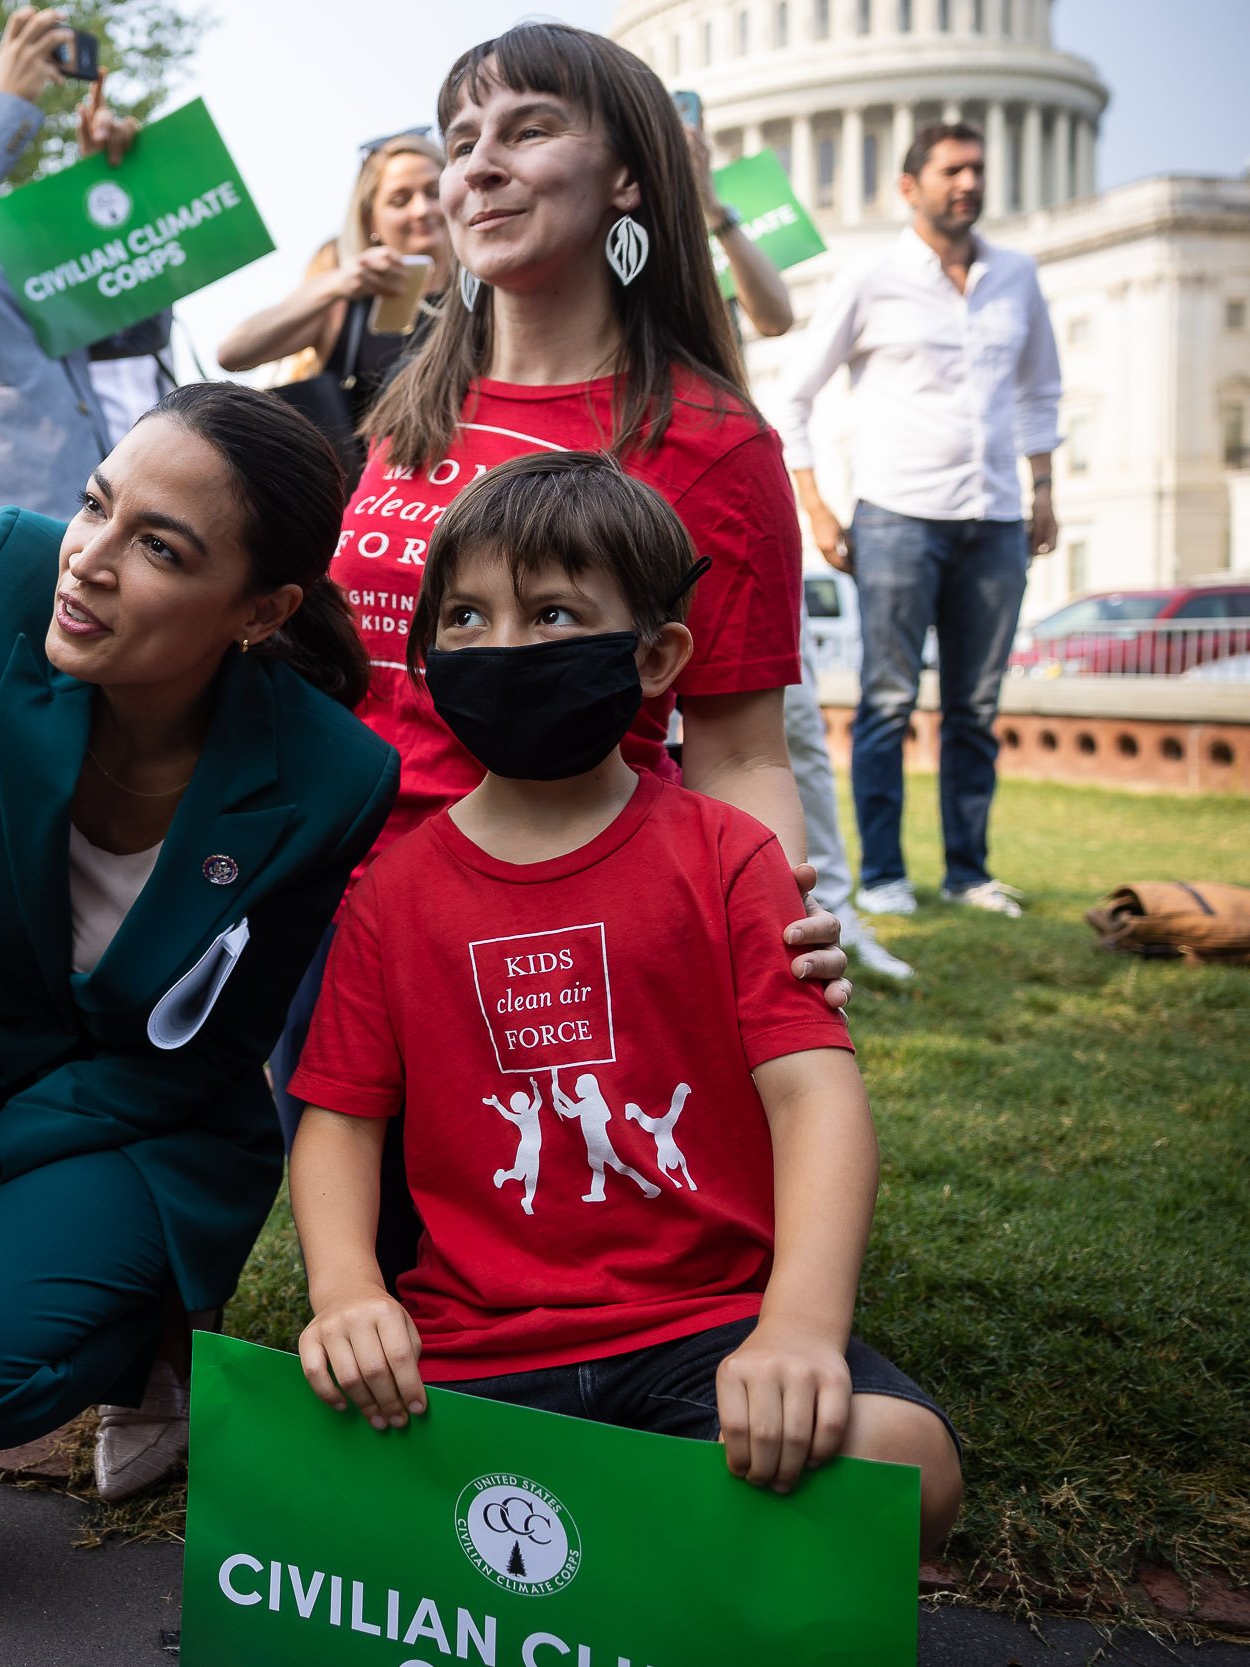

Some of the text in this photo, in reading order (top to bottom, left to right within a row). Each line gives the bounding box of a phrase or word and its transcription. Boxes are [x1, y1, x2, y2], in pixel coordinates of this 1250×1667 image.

[24, 239, 128, 301] CIVILIAN
[127, 181, 241, 253] CLIMATE
[97, 241, 186, 297] CORPS
[333, 530, 427, 566] FOR
[347, 589, 414, 612] GHTIN
[362, 614, 408, 635] KIDS
[505, 949, 574, 977] KIDS
[497, 981, 592, 1014] clean air
[505, 1020, 593, 1050] FORCE
[474, 1475, 562, 1514] UNITED STATES
[483, 1497, 551, 1545] CCC
[457, 1518, 580, 1594] CIVILIAN CLIMATE CORPS
[219, 1553, 496, 1667] CIVILIAN
